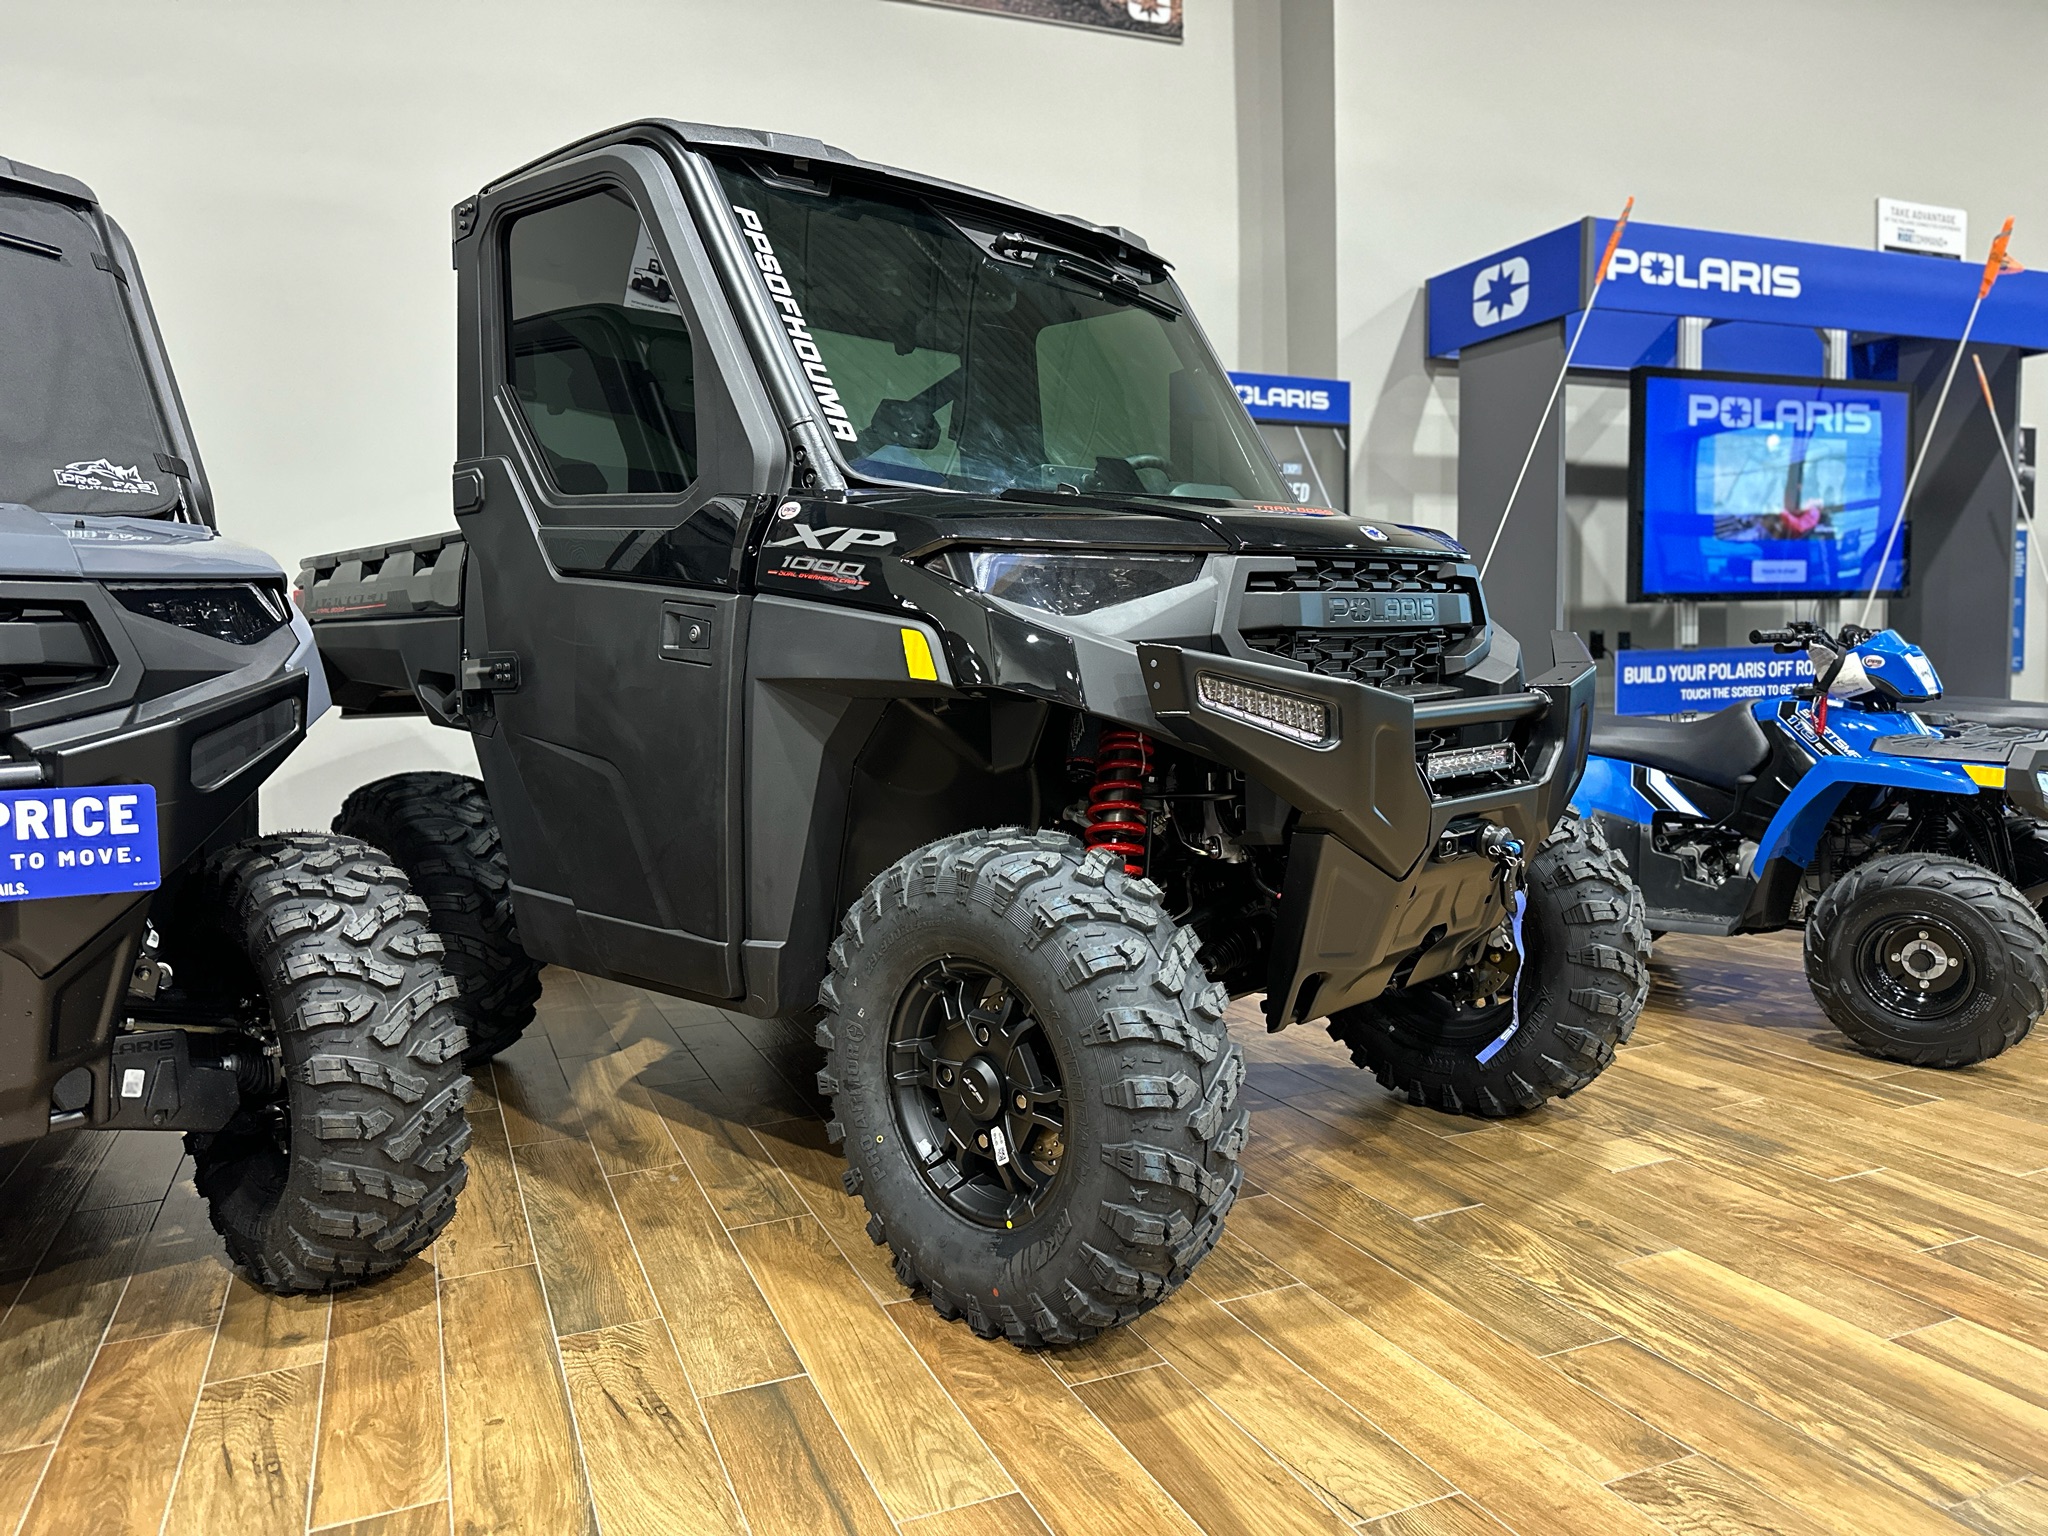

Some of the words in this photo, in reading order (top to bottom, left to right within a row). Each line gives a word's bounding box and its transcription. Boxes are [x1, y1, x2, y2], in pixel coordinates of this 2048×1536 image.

[1891, 206, 1910, 219] TAKE
[1912, 210, 1956, 225] ADVANTAGE
[1606, 247, 1801, 299] POLARIS
[732, 205, 858, 443] PPSOFHOUMA
[1234, 384, 1330, 411] OLARIS
[1688, 394, 1873, 434] POLARIS
[62, 473, 102, 486] PRO
[112, 481, 152, 492] FAB
[764, 523, 898, 552] XP
[781, 555, 867, 577] 1000
[798, 573, 840, 583] OVERHEAD
[838, 577, 859, 585] CAM
[1329, 597, 1436, 623] POLARIS
[1624, 665, 1668, 685] BUILD
[1668, 663, 1706, 683] YOUR
[1707, 662, 1767, 681] POLARIS
[1768, 660, 1794, 678] OFF
[1796, 660, 1816, 676] RO
[1681, 687, 1711, 701] TOUCH
[1712, 687, 1730, 700] THE
[1731, 685, 1766, 698] SCREEN
[1767, 684, 1779, 696] TO
[1787, 714, 1820, 744] 110
[9, 852, 45, 871] TO
[57, 846, 142, 868] MOVE.
[846, 1043, 869, 1129] ARMOR
[859, 1132, 888, 1184] PRO
